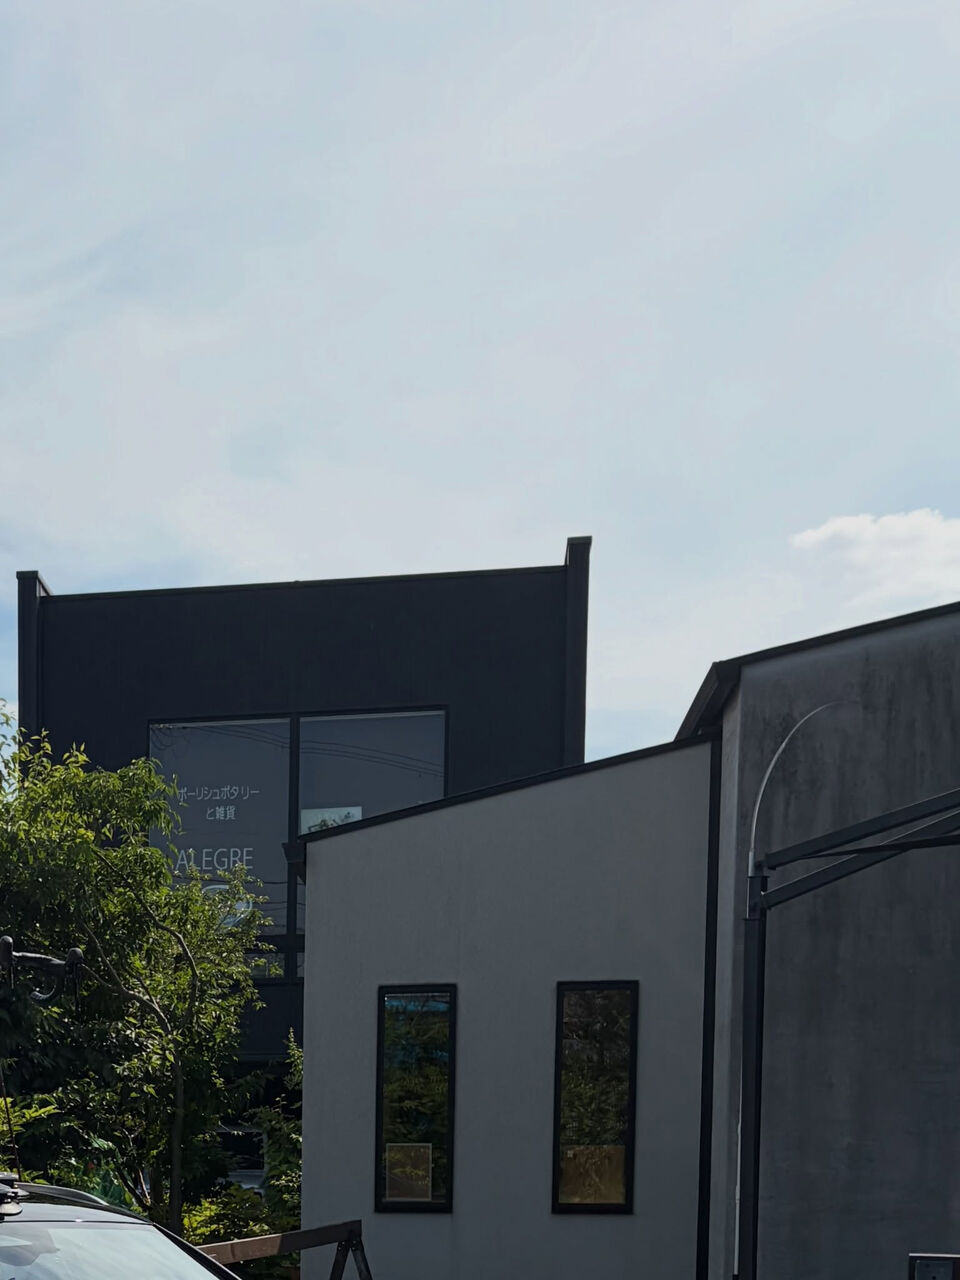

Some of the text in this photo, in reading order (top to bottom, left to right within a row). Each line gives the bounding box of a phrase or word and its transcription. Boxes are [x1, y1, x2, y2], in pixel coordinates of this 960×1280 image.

[206, 805, 236, 821] と雑貨
[175, 847, 254, 870] ALEGRE
